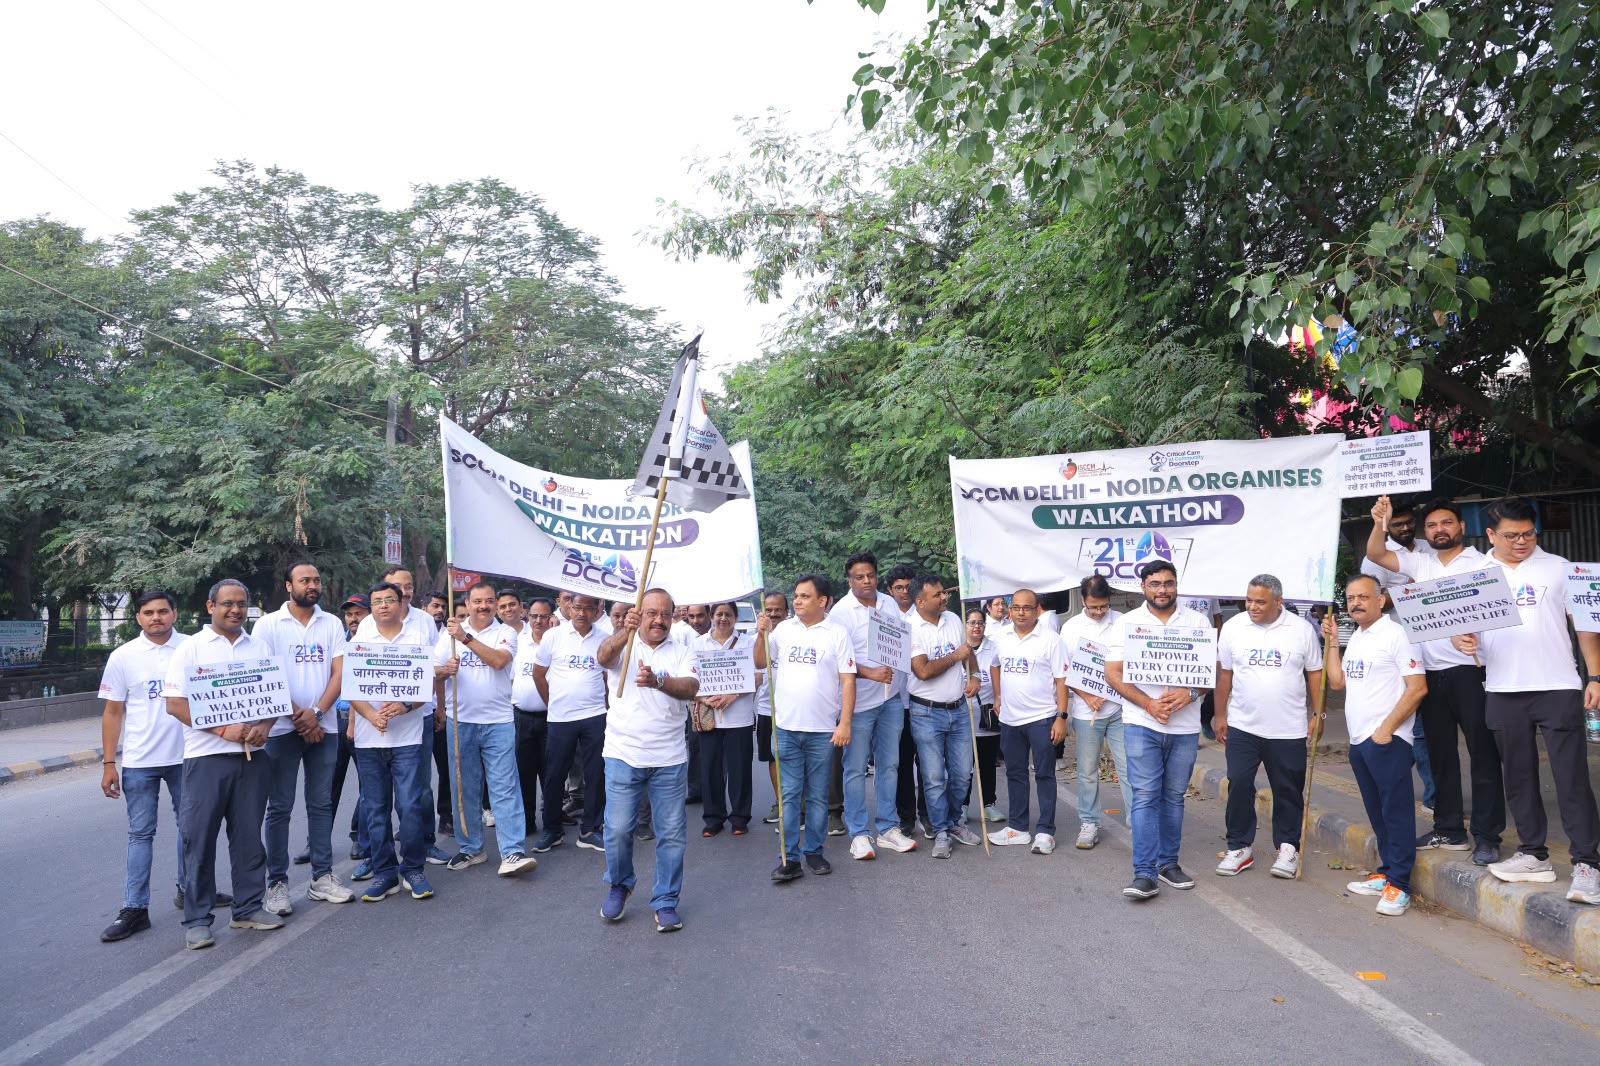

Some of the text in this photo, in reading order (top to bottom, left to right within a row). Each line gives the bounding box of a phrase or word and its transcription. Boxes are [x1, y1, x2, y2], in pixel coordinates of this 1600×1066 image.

[686, 437, 712, 451] oorstep
[1364, 450, 1402, 460] WALKATHON
[1350, 457, 1418, 473] आधुनिक तकनीक और
[1397, 467, 1425, 476] आईसीयू
[1024, 484, 1085, 501] DELHI
[1107, 475, 1184, 497] NOIDA
[1188, 468, 1323, 492] ORGANISES
[1360, 483, 1368, 491] हर
[510, 480, 562, 512] DELHI
[582, 504, 652, 521] NOIDA
[1053, 501, 1222, 526] WALKATHON
[531, 510, 682, 547] WALKATHON
[562, 559, 638, 593] DCCS
[1397, 594, 1417, 603] SCCM
[1416, 591, 1435, 600] DELHI
[1439, 586, 1460, 595] NOIDA
[1461, 578, 1499, 590] ORGANISES
[1427, 590, 1474, 604] WALKATHON
[1403, 598, 1513, 625] YOUR AWARENESS,
[1412, 608, 1510, 633] SOMEONE'S LIFE
[877, 632, 903, 649] RESPOND
[1151, 642, 1189, 650] WALKATHON
[876, 642, 903, 659] WITHOUT
[1141, 650, 1199, 662] EMPOWER
[295, 655, 325, 663] DCCS
[789, 655, 817, 665] DCCS
[880, 655, 899, 668] DELAY
[1249, 658, 1282, 668] DCCS
[229, 670, 248, 678] NOIDA
[248, 666, 280, 675] ORGANISES
[353, 667, 425, 681] जागरूकता ही
[1004, 666, 1029, 674] DCCS
[1072, 661, 1095, 676] समय
[1127, 661, 1213, 675] EVERY CITIZEN
[217, 675, 258, 686] WALKATHON
[700, 674, 747, 684] OMMUNITY
[1128, 672, 1211, 686] TO SAVE A LIFE
[191, 681, 285, 702] WALK FOR LIFE
[358, 682, 421, 698] पहली सुरक्षा
[720, 683, 744, 691] LIVES
[209, 696, 273, 713] WALK FOR
[194, 703, 289, 726] CRITICAL CARE
